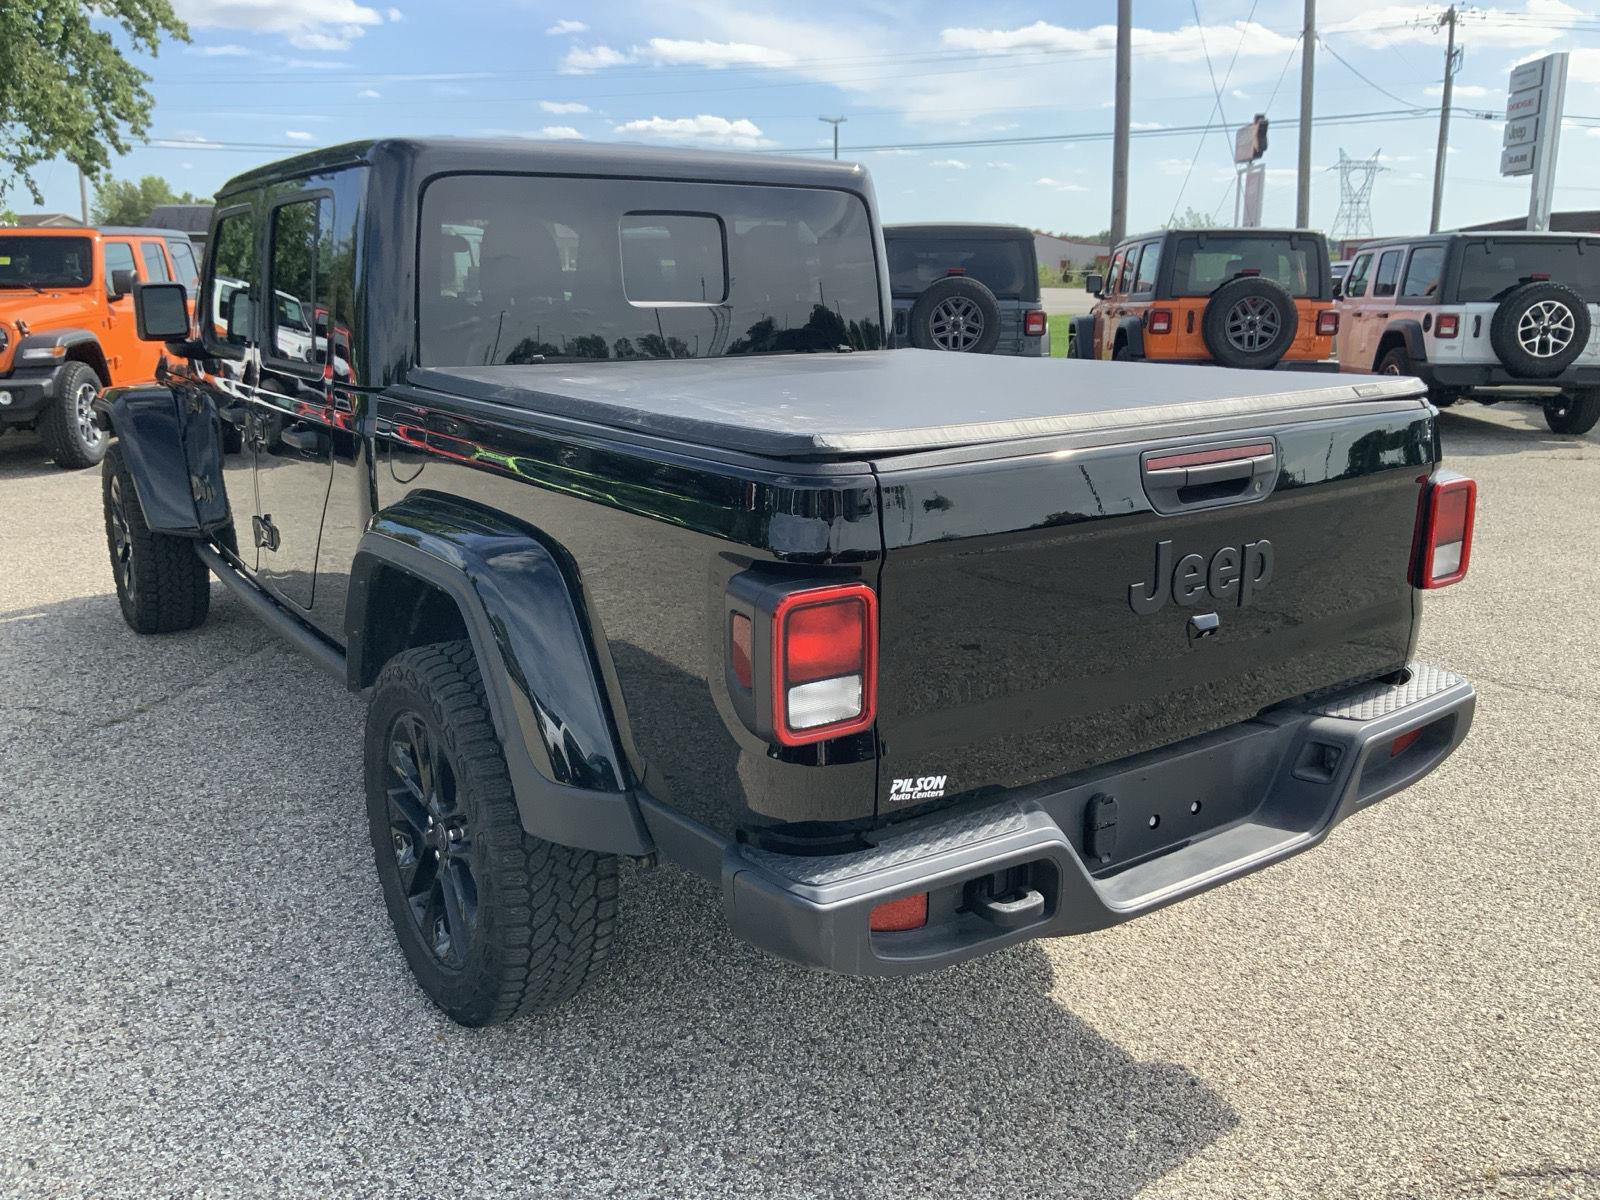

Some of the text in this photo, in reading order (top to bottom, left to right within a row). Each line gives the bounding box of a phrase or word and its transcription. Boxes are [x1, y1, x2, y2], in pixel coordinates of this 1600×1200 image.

[1508, 124, 1526, 141] Jeep
[1128, 539, 1274, 615] Jeep
[890, 775, 947, 794] PILSON
[889, 790, 945, 801] Auto Centers
